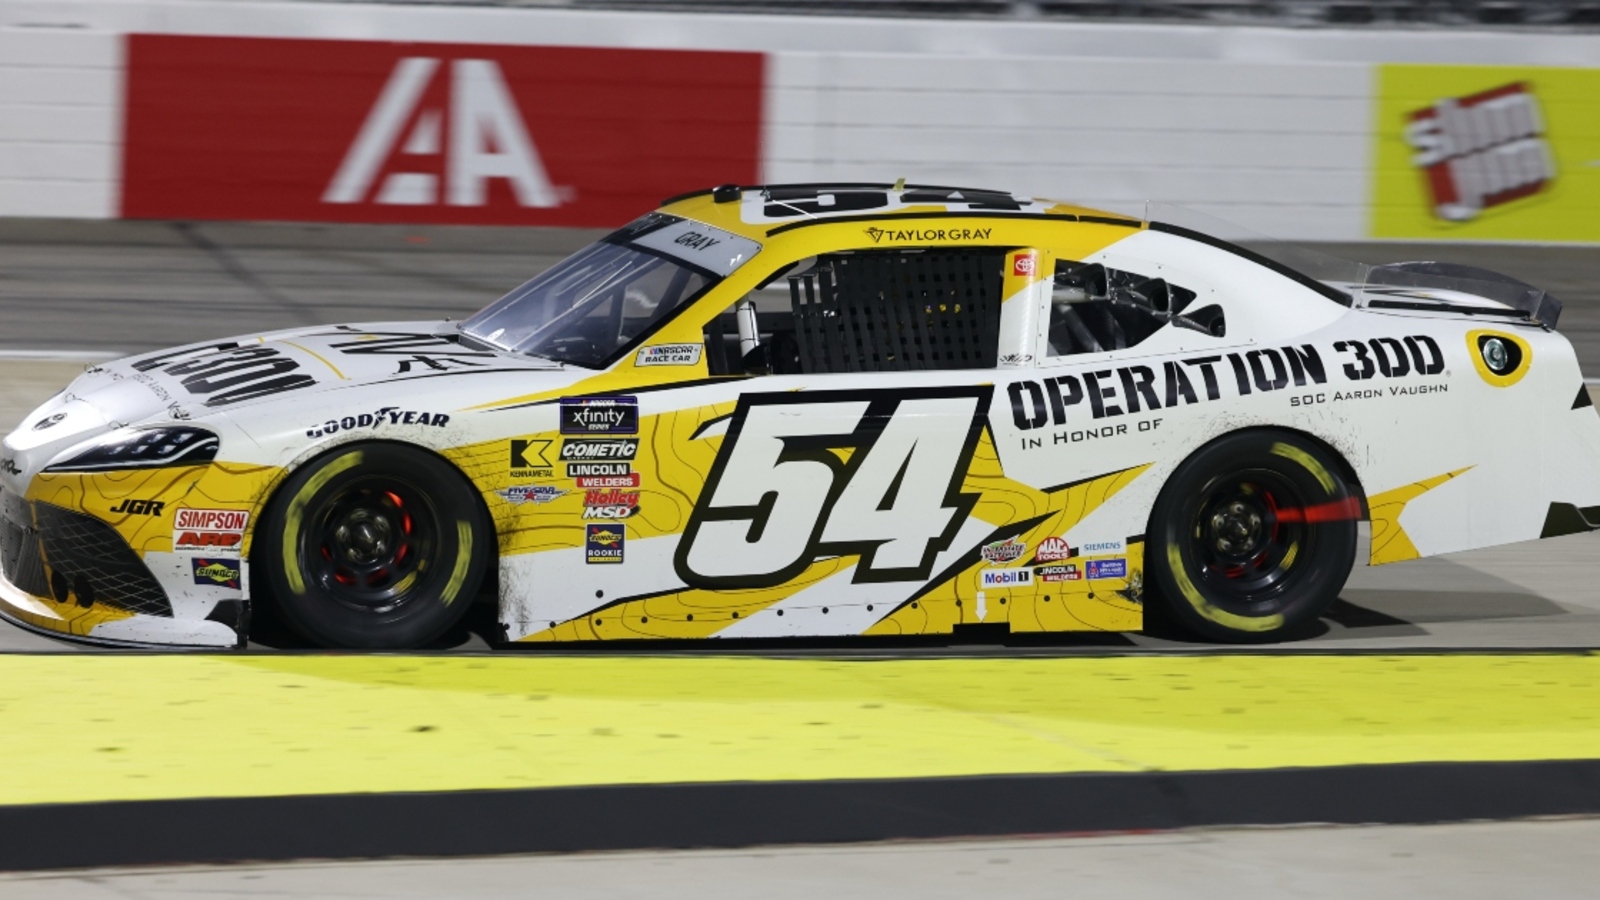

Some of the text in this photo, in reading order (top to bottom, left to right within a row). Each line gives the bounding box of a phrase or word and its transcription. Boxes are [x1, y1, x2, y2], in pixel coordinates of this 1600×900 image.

[674, 231, 721, 251] GRAY
[672, 355, 691, 363] CAR
[1006, 334, 1445, 431] OPERATION 300
[1389, 383, 1449, 397] VAUGHN
[573, 408, 625, 427] xfinity
[1021, 418, 1164, 450] IN HONOR OF
[562, 442, 636, 457] COMETIC
[510, 470, 554, 478] KENNAMETAL
[569, 465, 627, 476] LINCOLN
[582, 478, 633, 487] WELDERS
[674, 384, 993, 589] 54
[585, 490, 639, 507] Holley
[110, 499, 165, 517] JGR
[583, 507, 631, 519] MSD
[178, 511, 245, 529] SIMPSON
[176, 531, 242, 546] ARP
[1038, 538, 1068, 553] MAC
[1084, 541, 1121, 551] SIEMENS
[1038, 552, 1067, 560] TOOLS
[198, 567, 239, 579] SUNOCO
[985, 571, 1017, 583] Mobil
